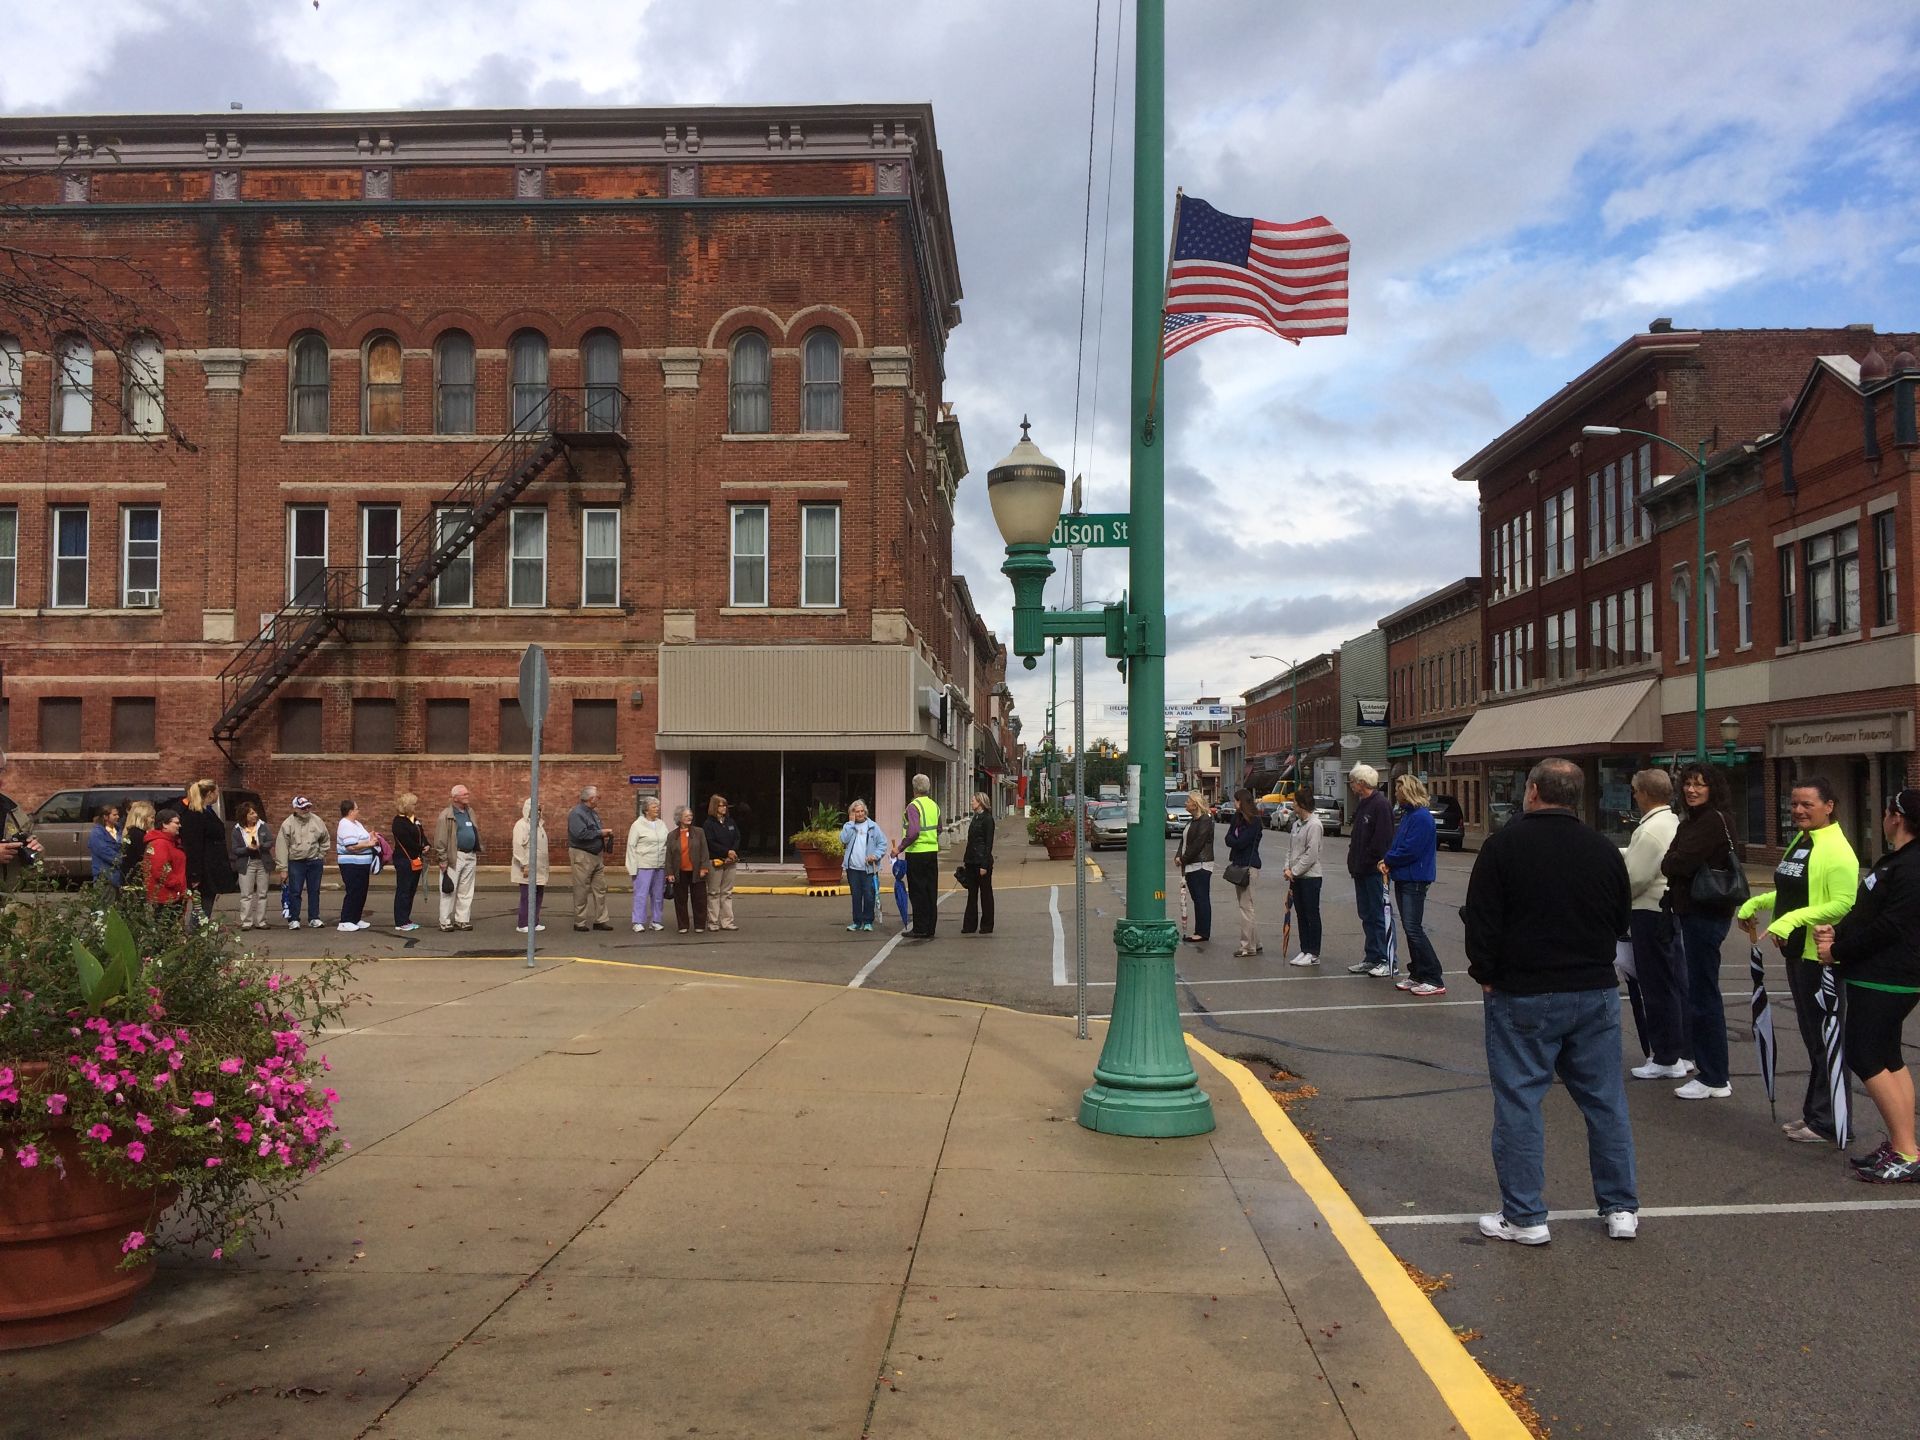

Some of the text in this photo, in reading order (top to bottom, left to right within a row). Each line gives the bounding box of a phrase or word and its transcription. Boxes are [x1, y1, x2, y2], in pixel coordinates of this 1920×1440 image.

[1050, 519, 1128, 543] dison St
[1177, 726, 1192, 734] 224
